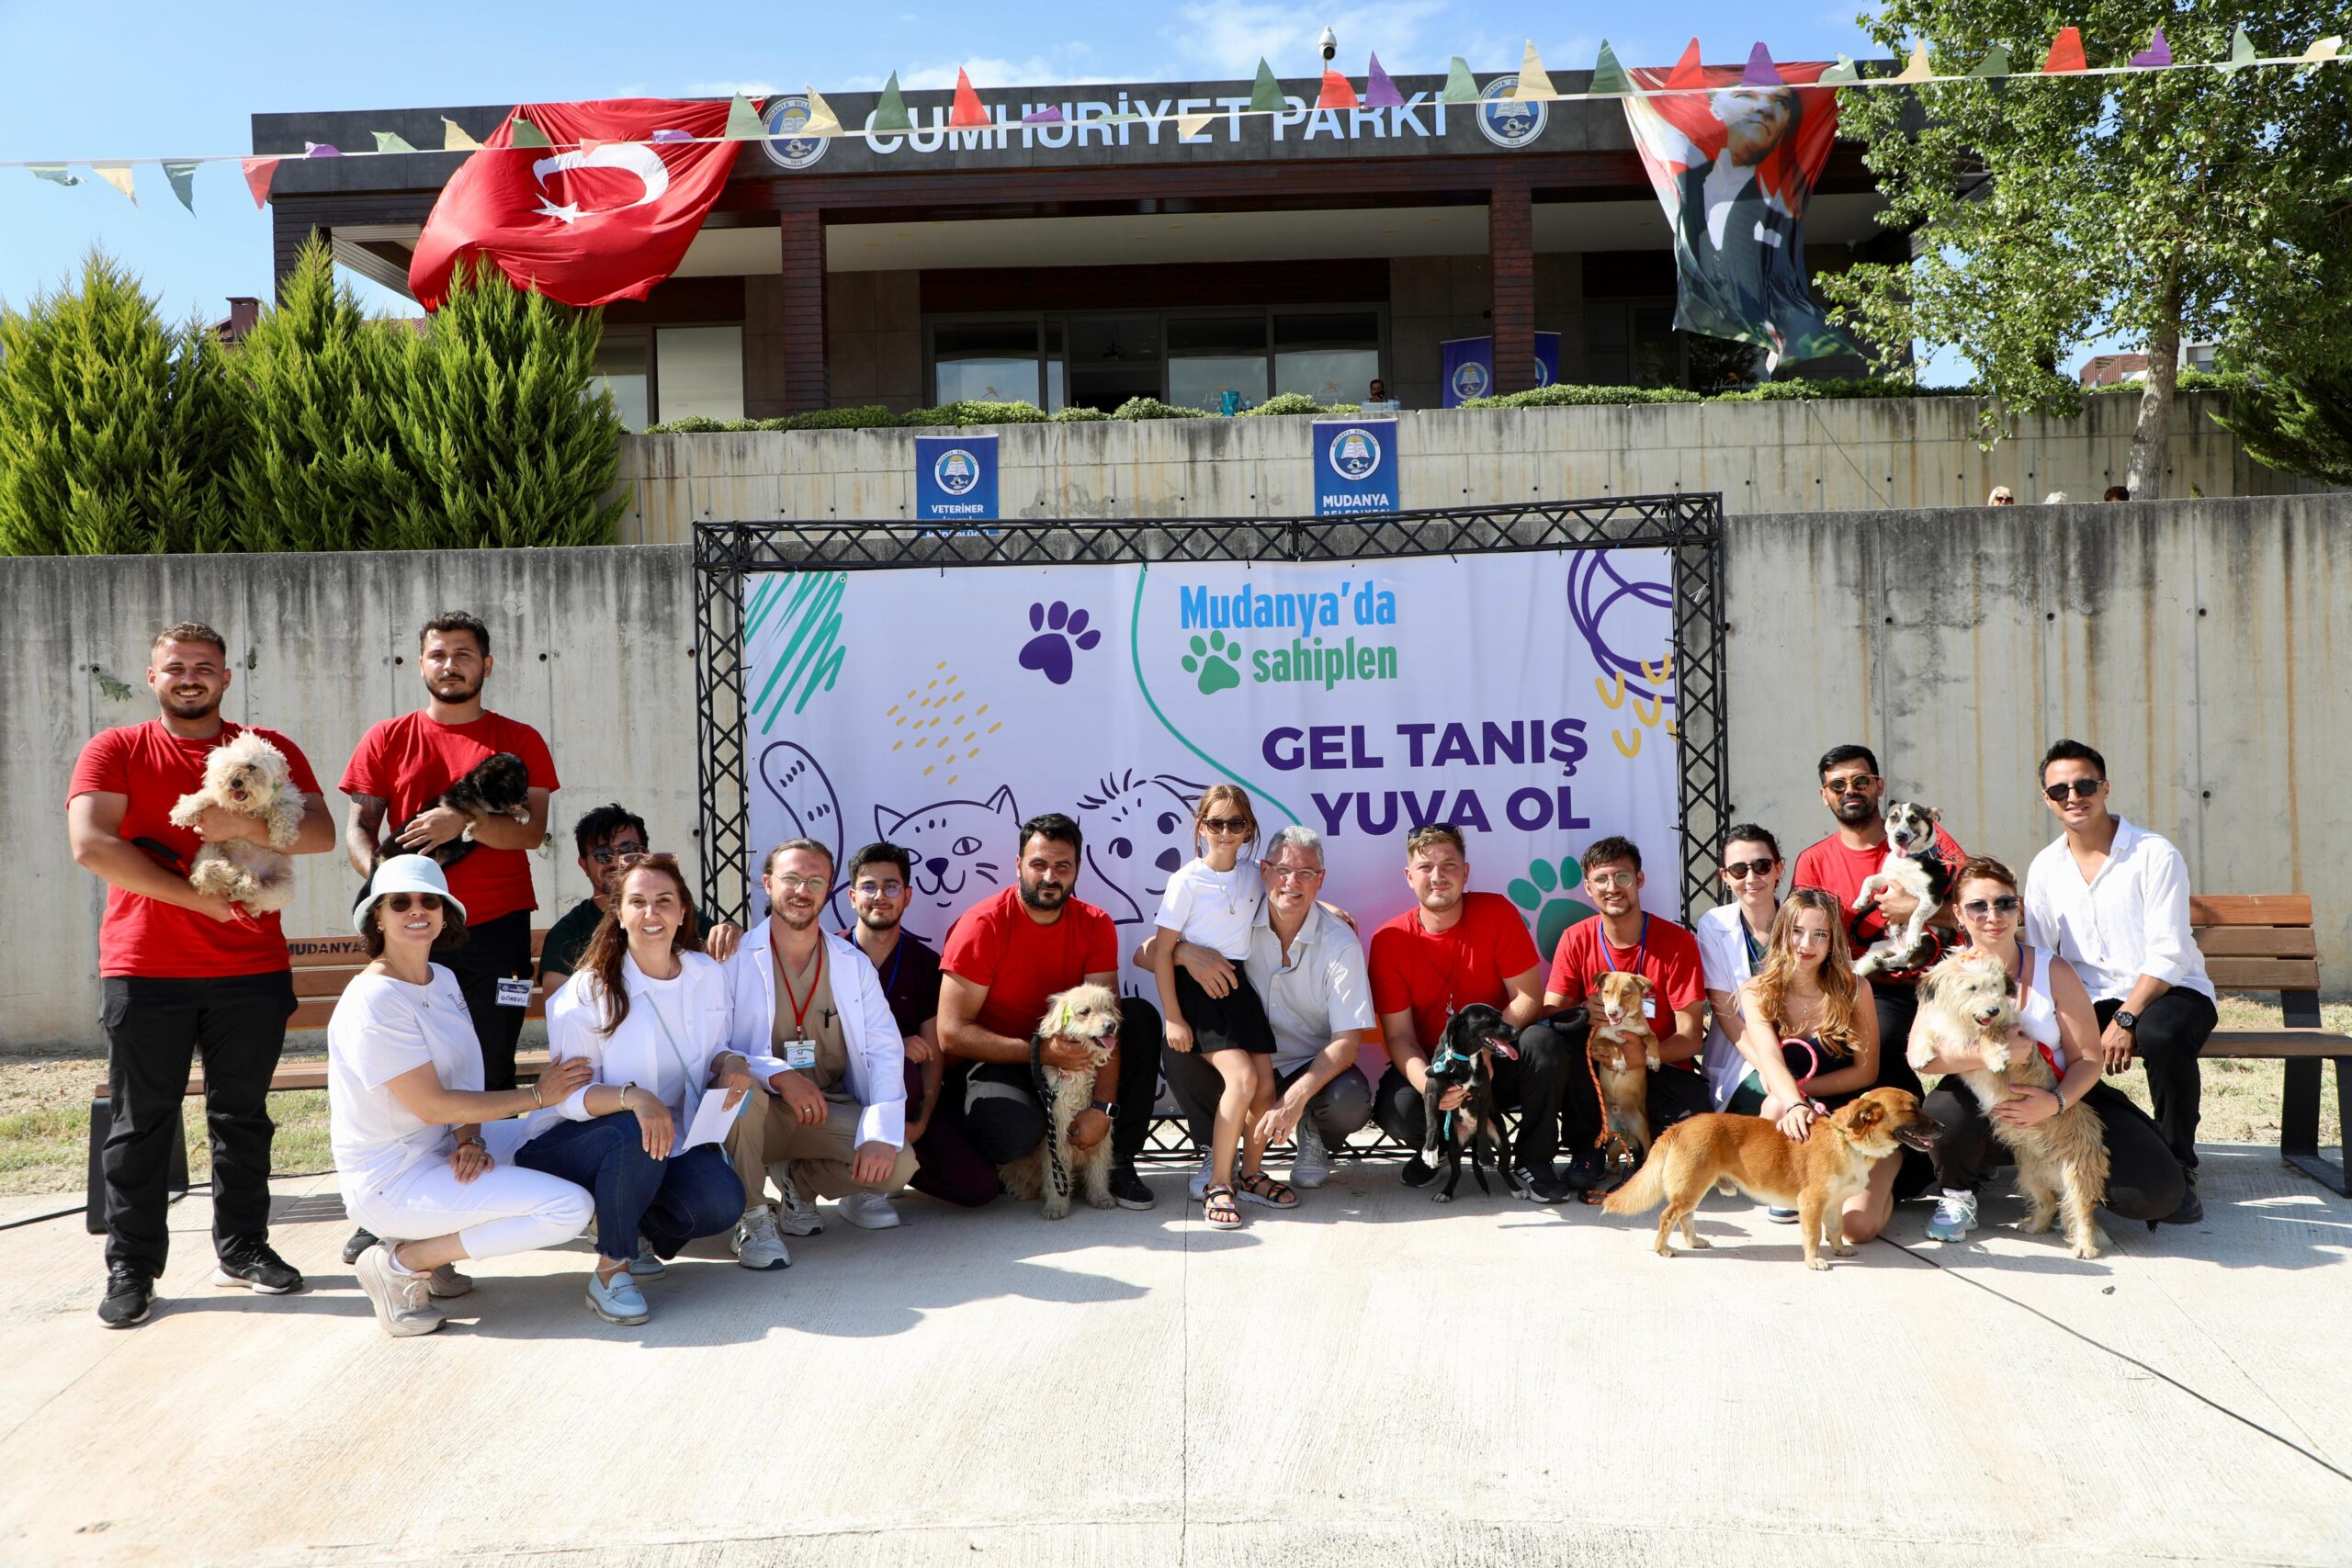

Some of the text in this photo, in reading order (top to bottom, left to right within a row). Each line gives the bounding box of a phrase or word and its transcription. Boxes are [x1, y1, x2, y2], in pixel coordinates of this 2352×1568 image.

[865, 91, 1448, 154] CUMHURİYET PARKI
[931, 502, 984, 513] VETERİNER
[1322, 493, 1390, 508] MUDANYA
[1251, 636, 1397, 692] sahiplen
[1261, 717, 1589, 777] GEL TANIŞ
[1310, 785, 1590, 837] YUVA OL
